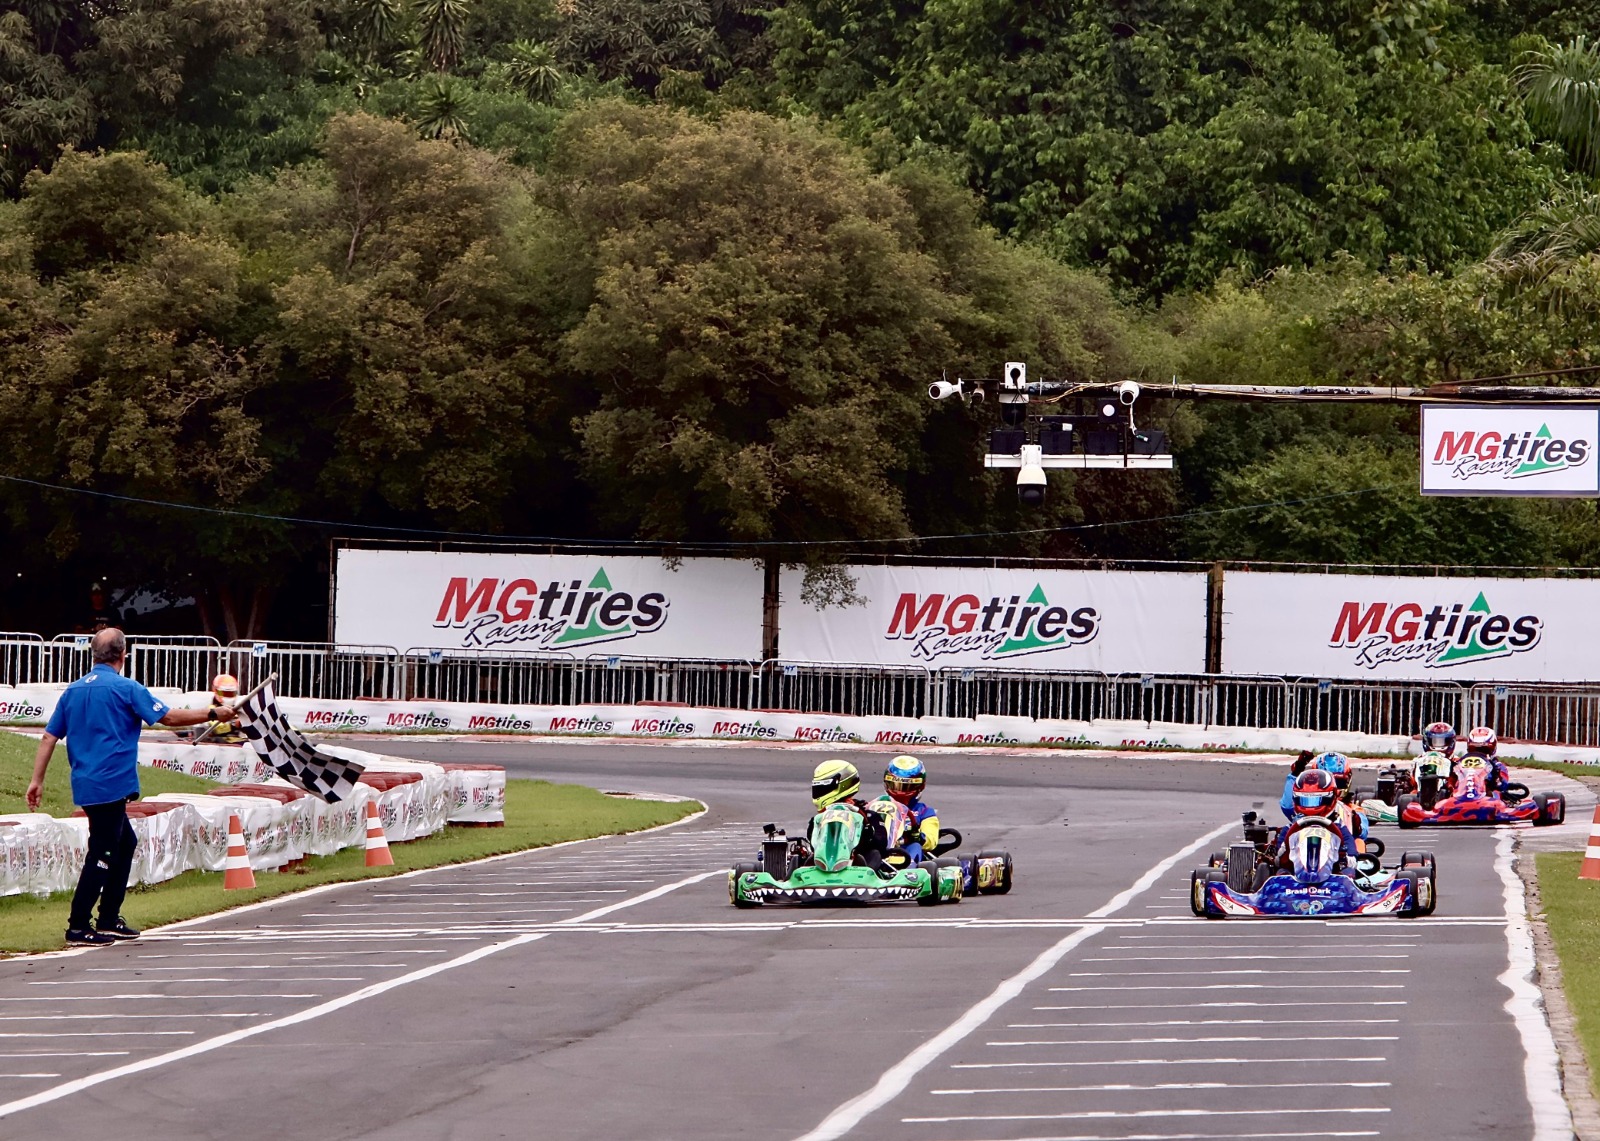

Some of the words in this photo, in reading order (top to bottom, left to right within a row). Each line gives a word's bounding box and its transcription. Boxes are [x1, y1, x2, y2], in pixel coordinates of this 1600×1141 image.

[1433, 431, 1588, 463] MGtires
[1453, 455, 1522, 476] Racing
[435, 576, 666, 628] MGtires
[887, 592, 1098, 641] MGtires
[1331, 601, 1540, 648] MGtires
[467, 613, 567, 646] Racing
[916, 627, 1010, 656] Racing
[1359, 634, 1452, 664] Racing
[305, 710, 368, 726] MGtires
[387, 712, 449, 728] MGtires
[468, 715, 532, 730] MGtires
[549, 717, 613, 732] MGtires
[631, 719, 694, 734] MGtires
[712, 721, 776, 737] MGtires
